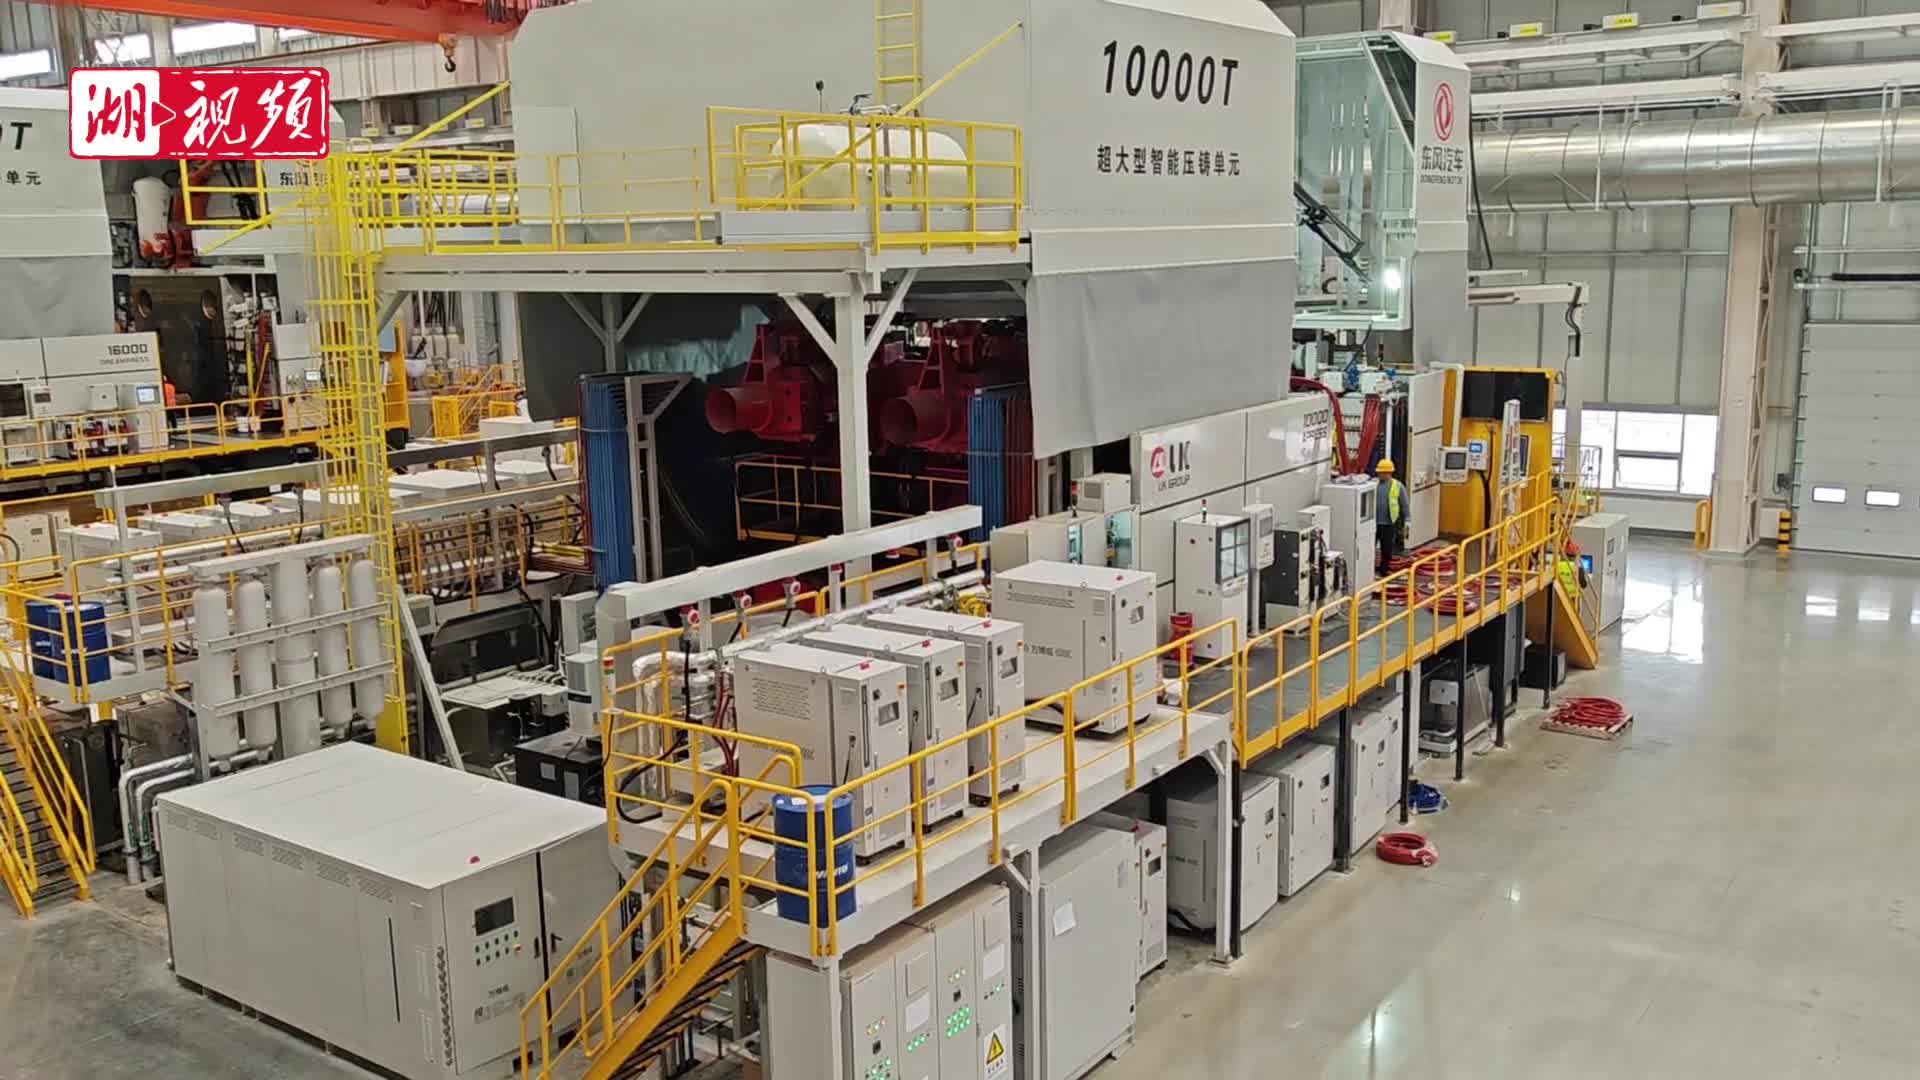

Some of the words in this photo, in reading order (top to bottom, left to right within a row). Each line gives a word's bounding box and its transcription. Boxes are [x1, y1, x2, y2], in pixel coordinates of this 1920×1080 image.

[1103, 39, 1239, 106] 10000T
[1097, 144, 1241, 177] 超大型智能压铸单元
[1422, 145, 1464, 172] 东风汽车
[0, 169, 42, 186] 单元
[107, 343, 149, 356] 16000
